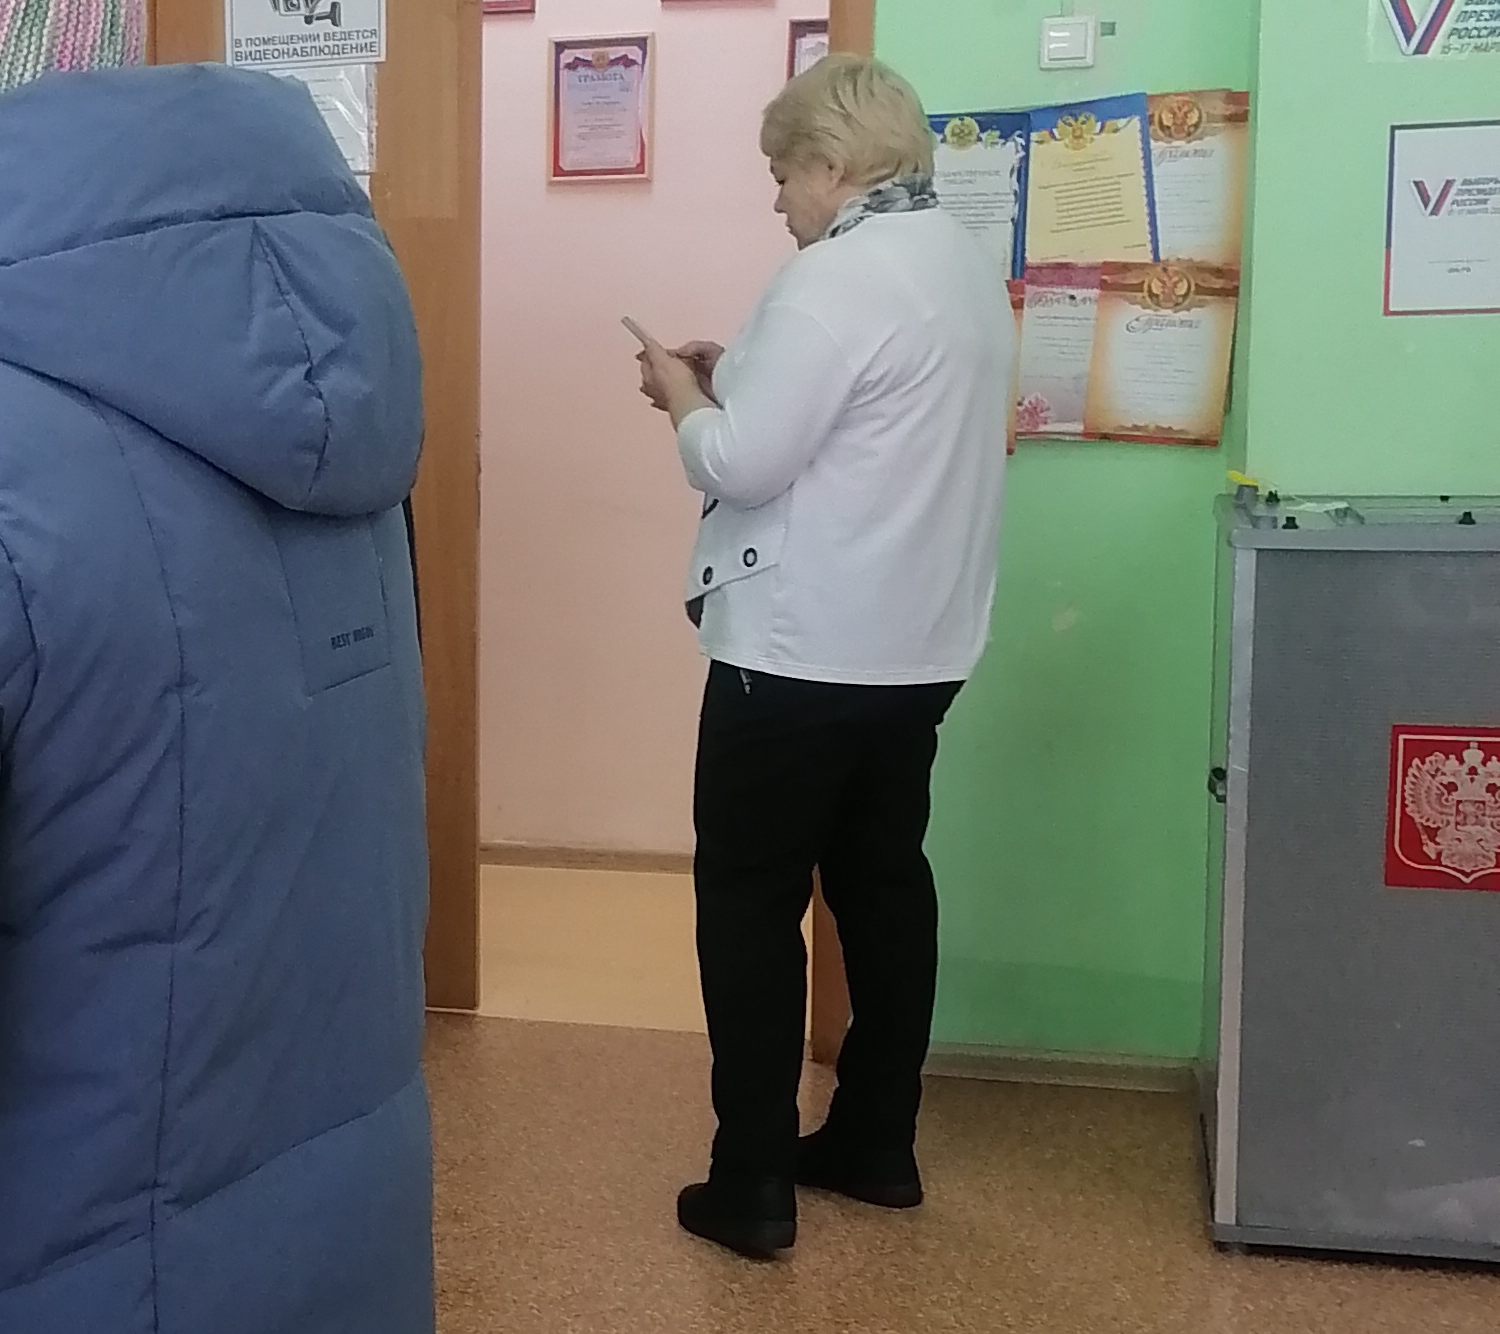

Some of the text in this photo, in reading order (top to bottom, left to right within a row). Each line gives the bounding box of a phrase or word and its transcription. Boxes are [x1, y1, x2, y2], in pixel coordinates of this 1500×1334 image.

[234, 29, 377, 48] В ПОМЕЩЕНИИ ВЕДЕТСЯ
[234, 41, 377, 62] ВИДЕОНАБЛЮДЕНИЕ
